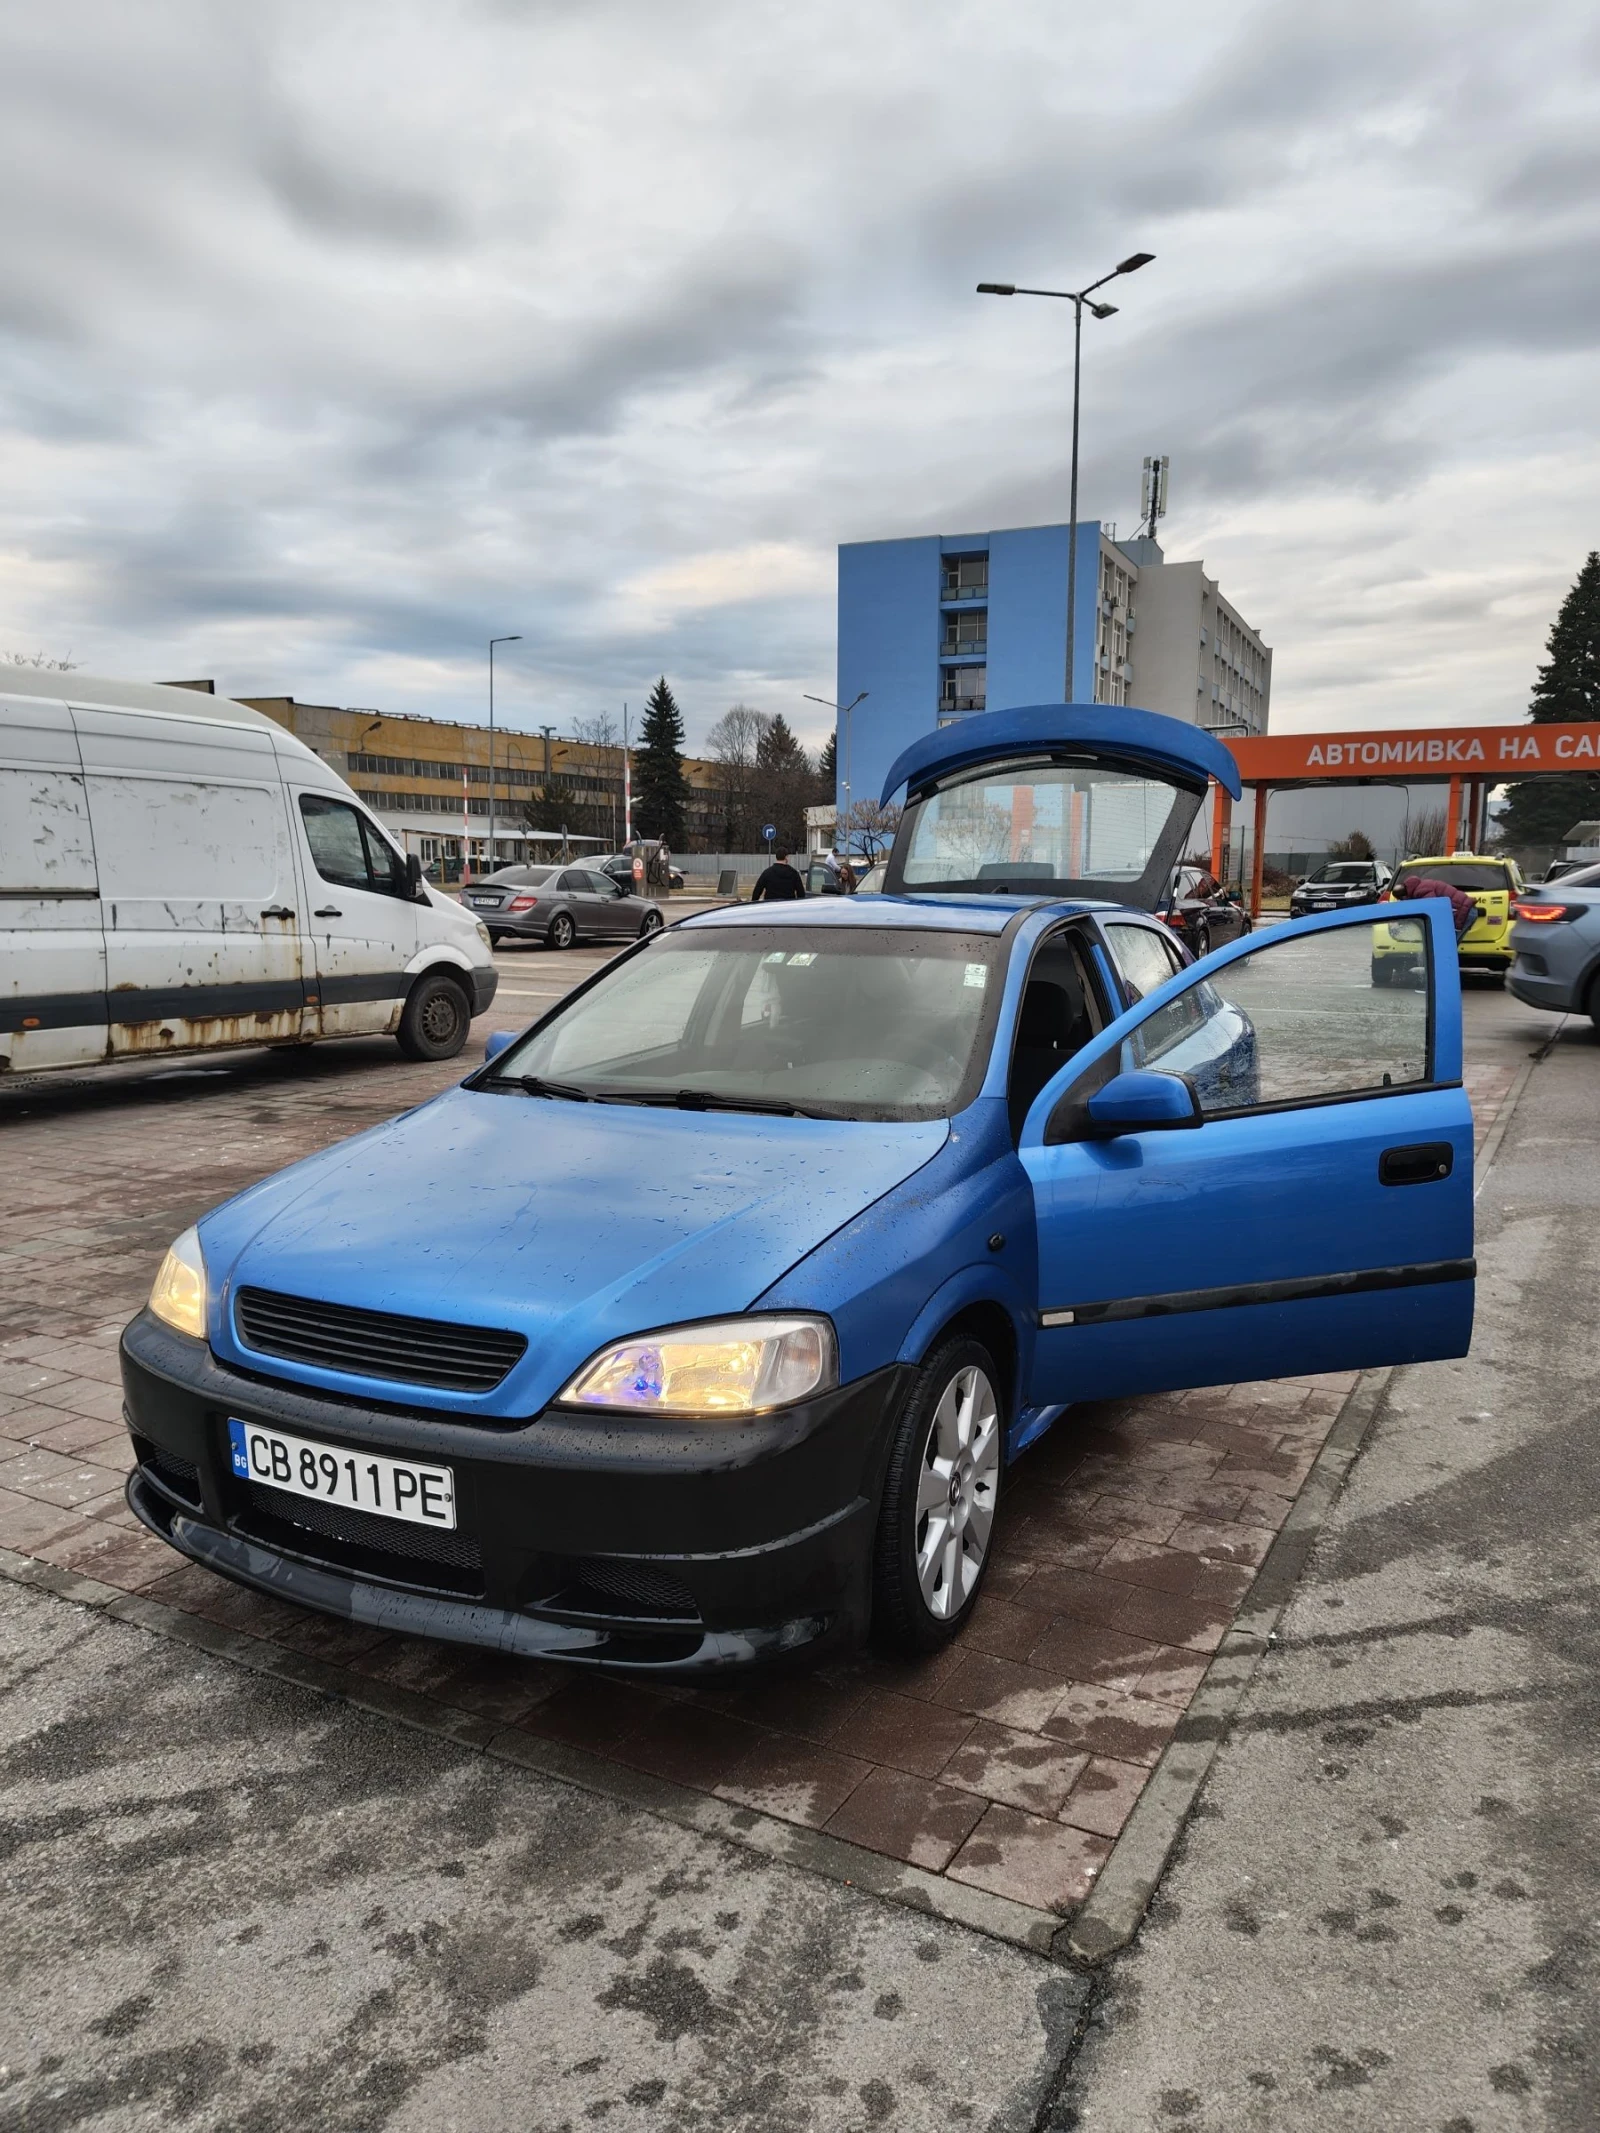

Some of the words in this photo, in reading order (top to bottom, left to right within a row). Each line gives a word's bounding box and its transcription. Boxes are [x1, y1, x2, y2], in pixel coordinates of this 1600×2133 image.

[1306, 739, 1485, 766] АВТОМИВКА
[1499, 736, 1541, 760] НА
[1555, 734, 1600, 758] СА
[234, 1454, 247, 1468] BG
[250, 1434, 292, 1483] CB
[299, 1447, 381, 1507] 8911
[392, 1467, 447, 1520] PE
